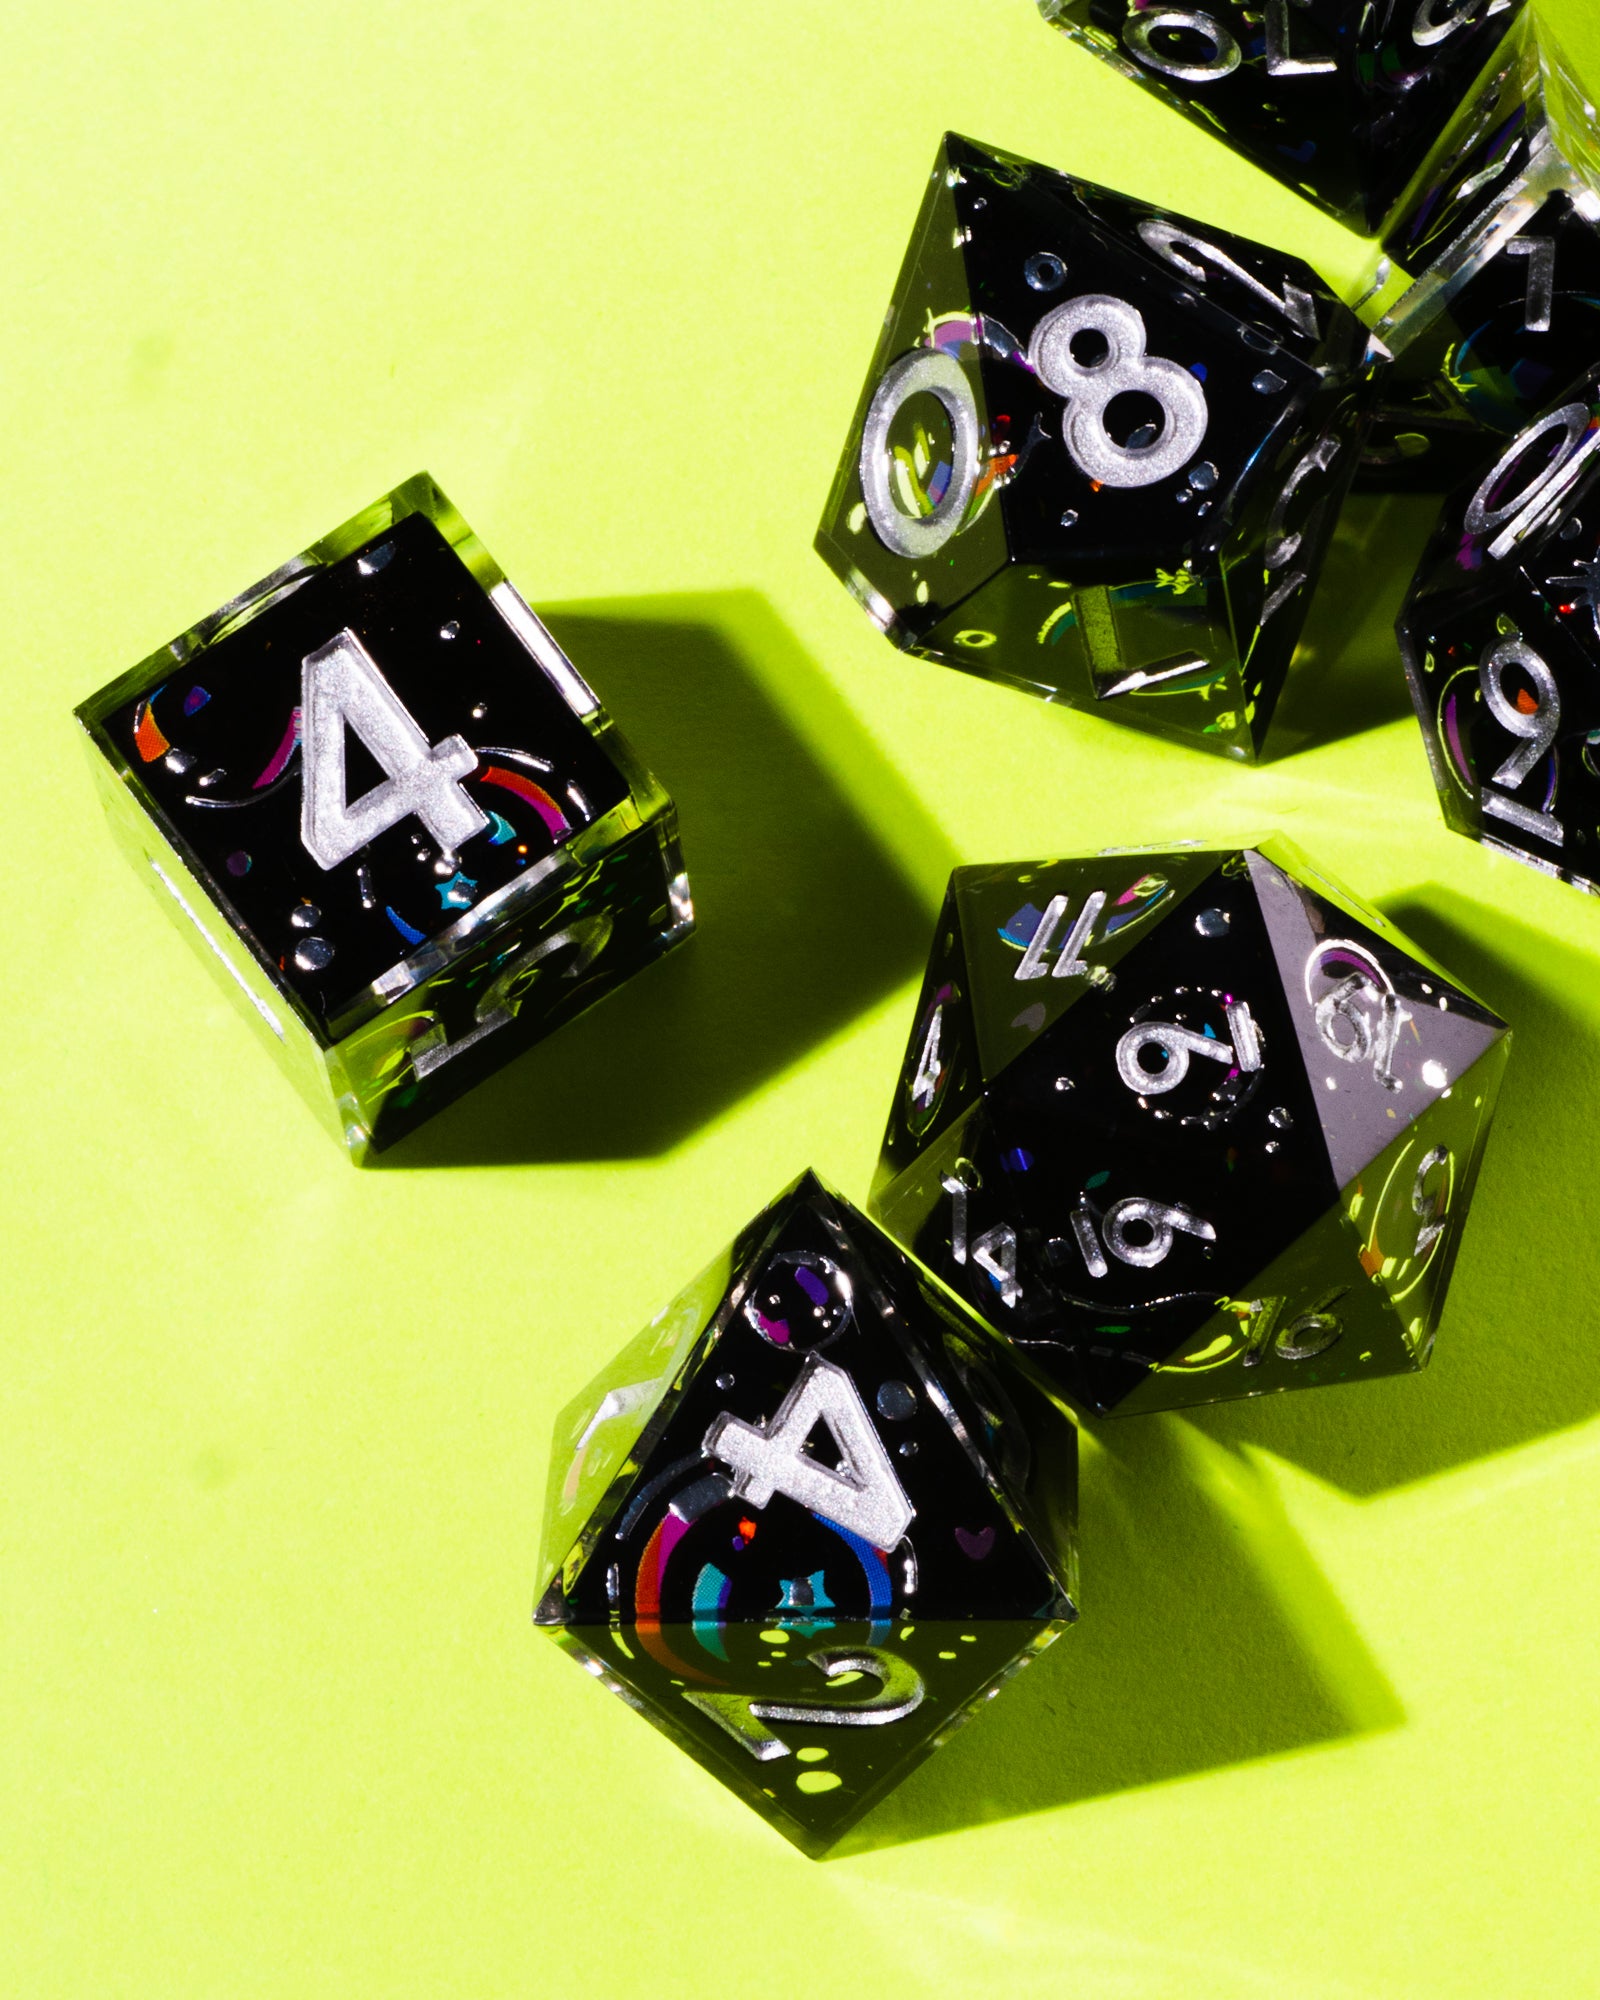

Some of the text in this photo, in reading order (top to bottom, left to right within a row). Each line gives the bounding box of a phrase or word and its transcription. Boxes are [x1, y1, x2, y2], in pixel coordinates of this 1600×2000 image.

[861, 348, 979, 559] 0
[1028, 294, 1208, 488] 8
[301, 627, 479, 870] 4
[702, 1352, 914, 1553] 4
[683, 1646, 926, 1762] 2
